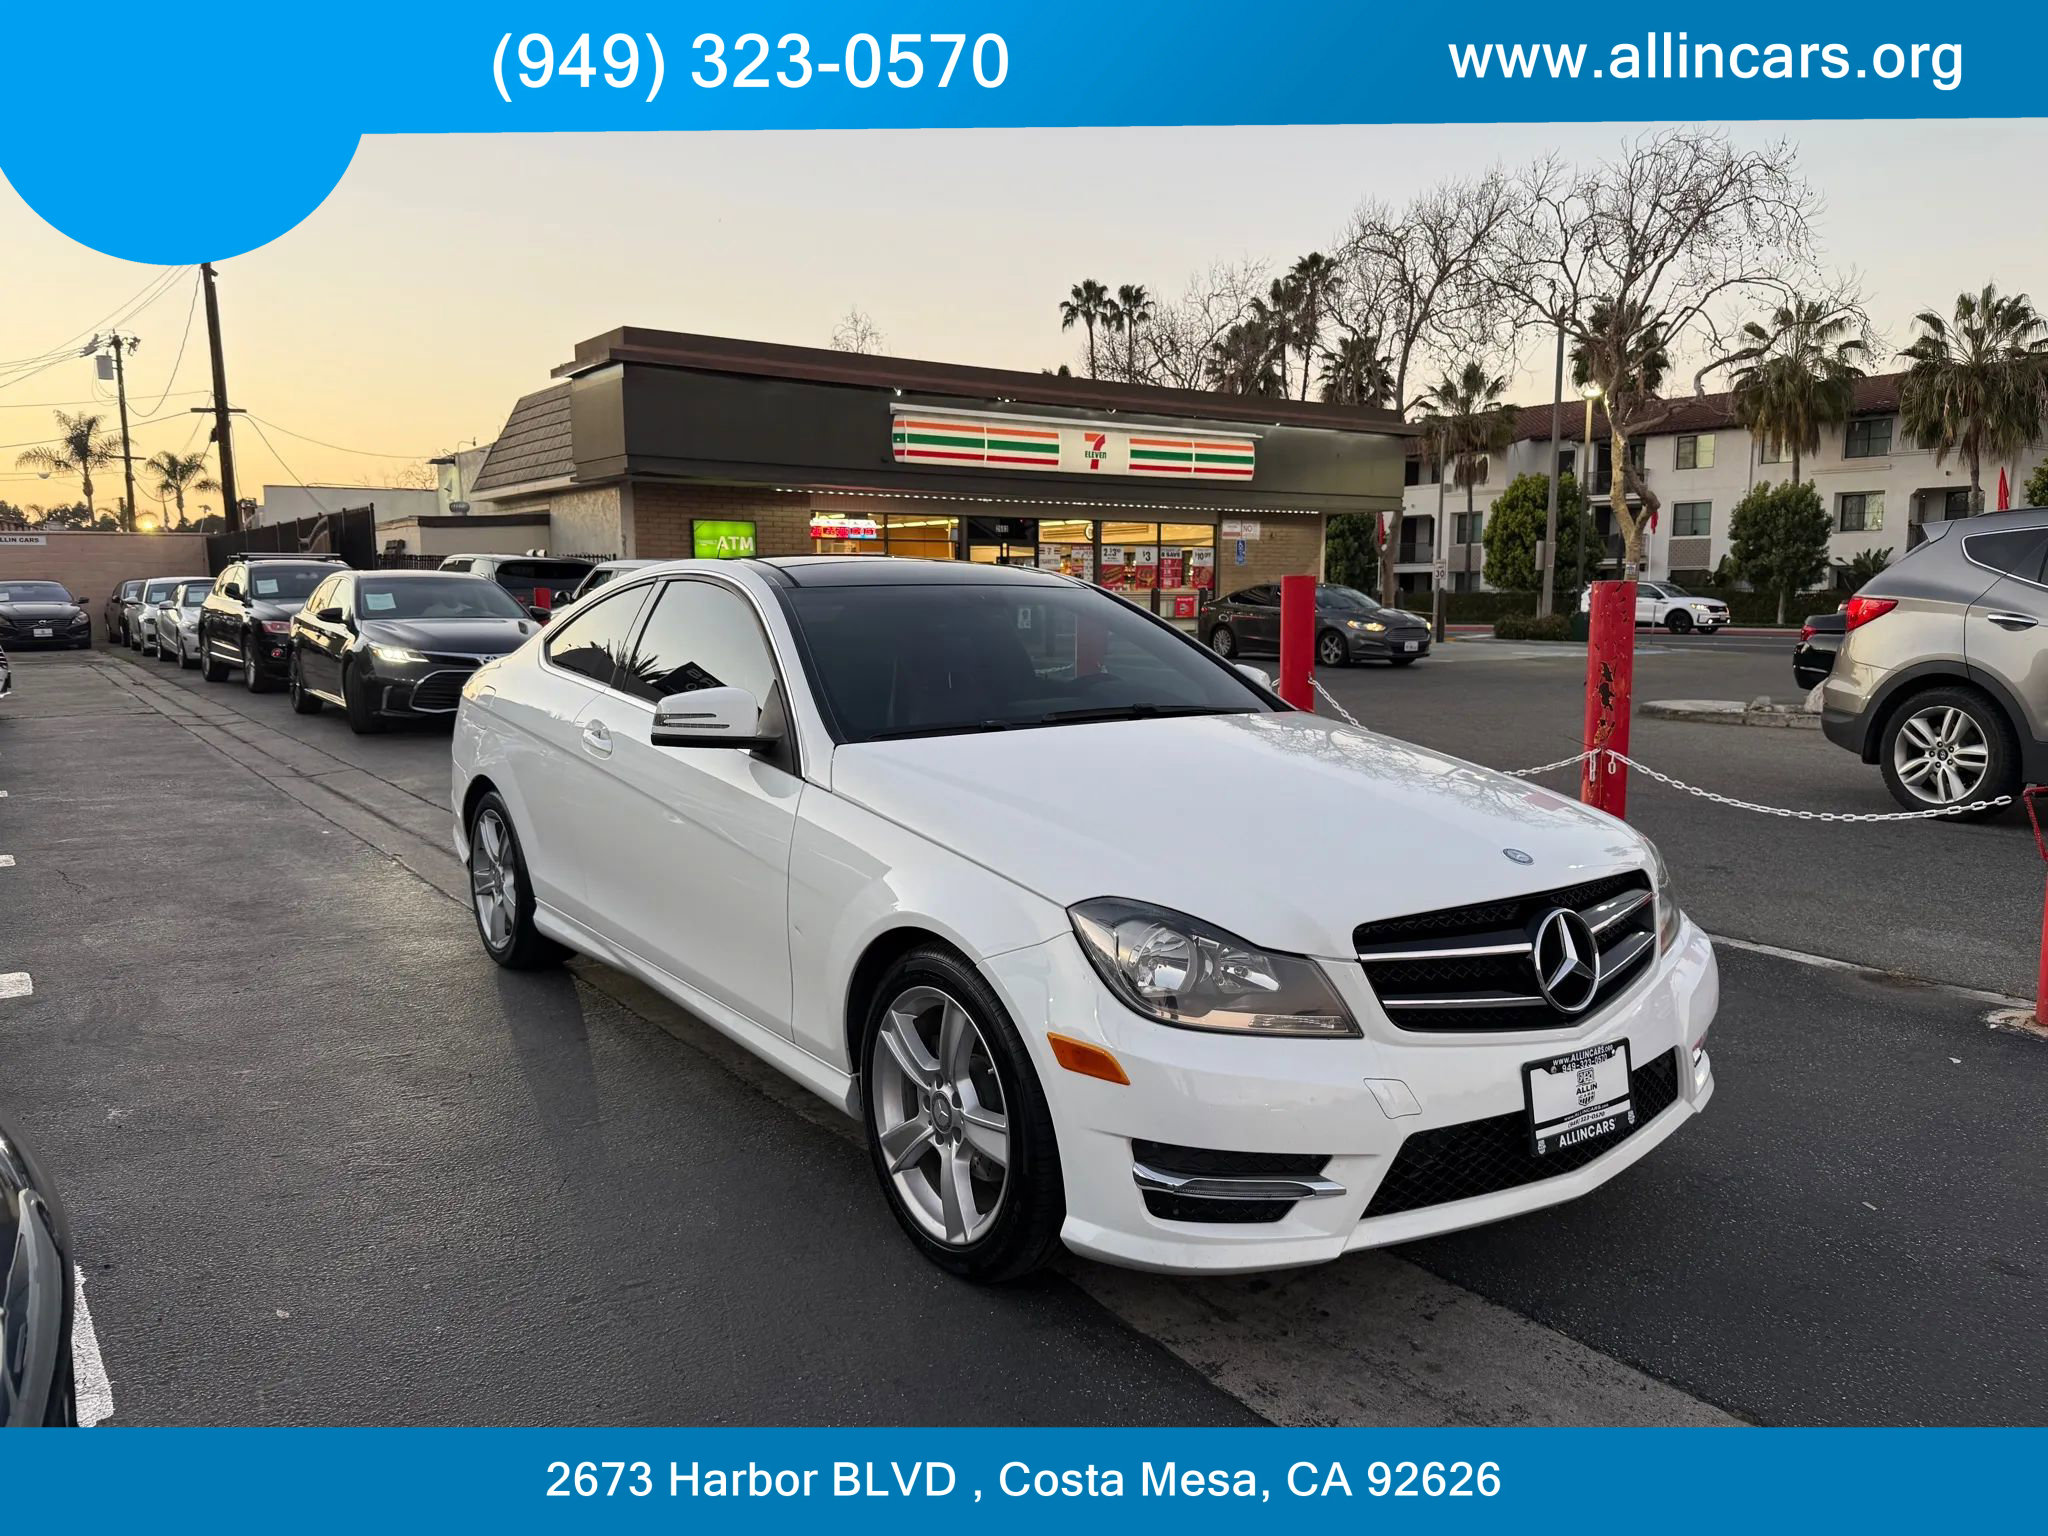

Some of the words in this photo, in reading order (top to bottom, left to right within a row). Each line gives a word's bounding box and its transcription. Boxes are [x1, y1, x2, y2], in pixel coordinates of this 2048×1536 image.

[1084, 432, 1106, 470] 7
[716, 535, 754, 551] ATM
[1575, 1082, 1598, 1095] ALLIN
[1559, 1118, 1616, 1148] ALLINCARS
